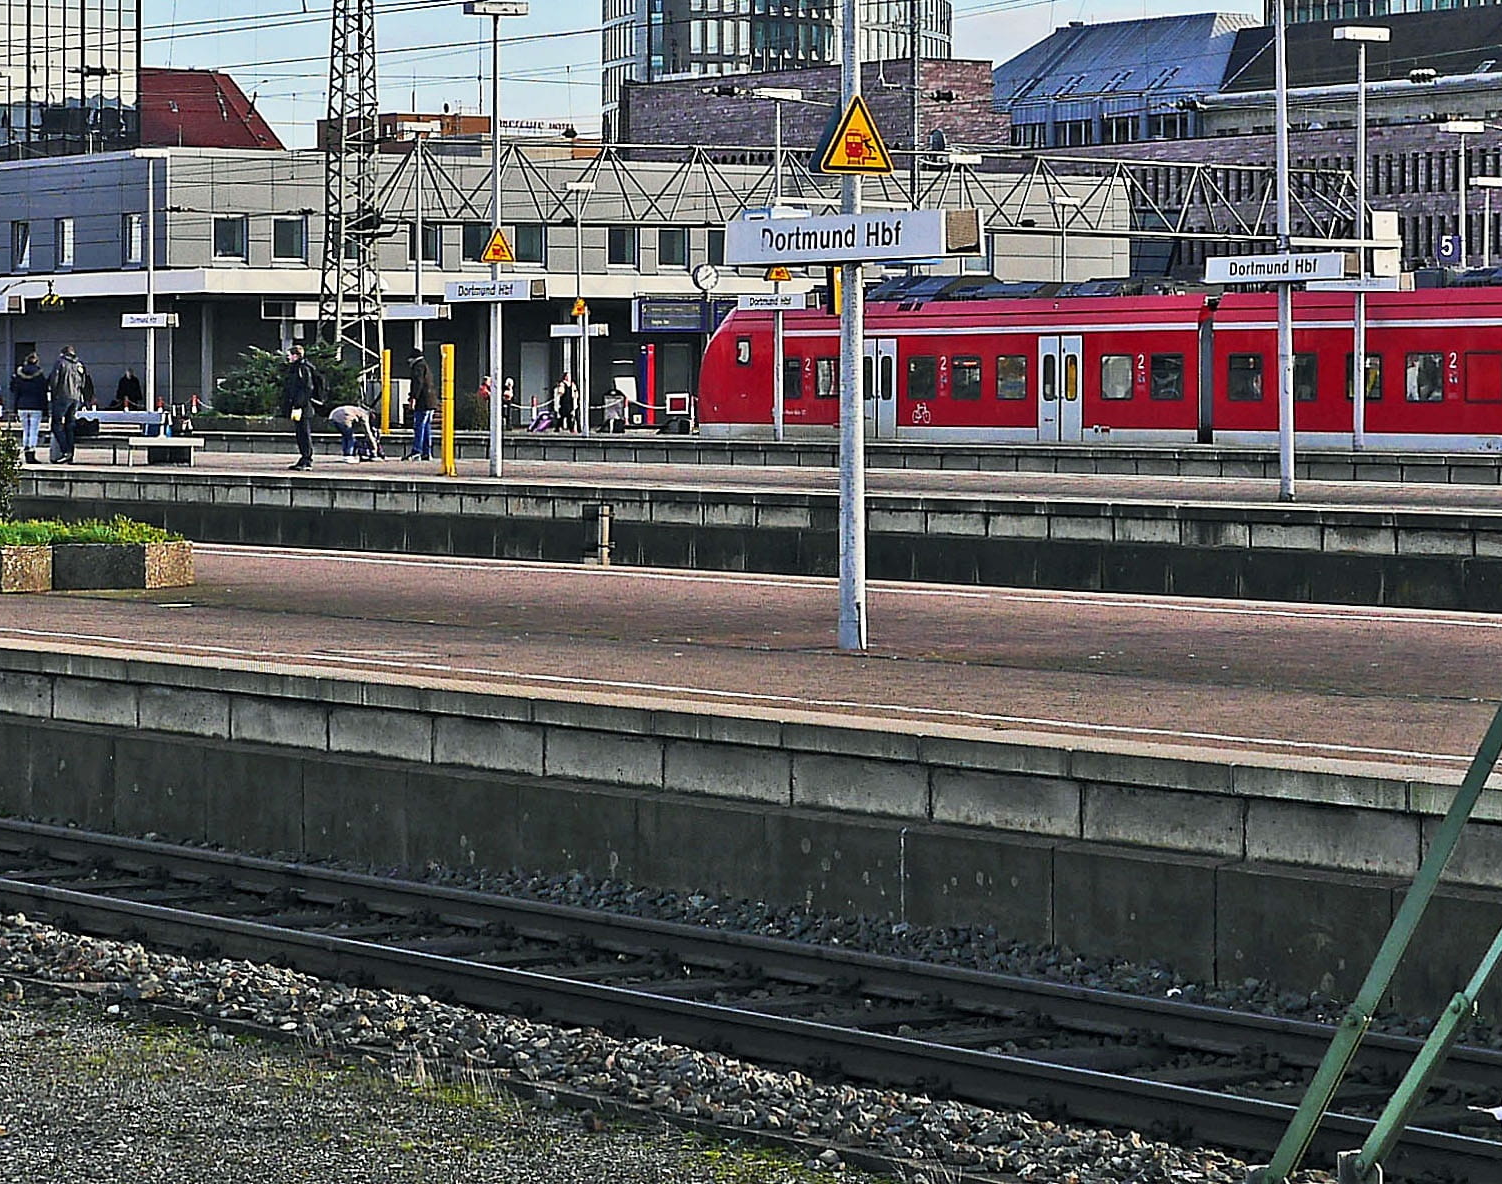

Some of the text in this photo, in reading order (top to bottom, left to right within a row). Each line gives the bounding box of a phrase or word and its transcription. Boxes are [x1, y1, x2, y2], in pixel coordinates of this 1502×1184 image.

[761, 220, 903, 252] Dortmund Hbf
[1440, 235, 1454, 256] 5
[1229, 257, 1319, 276] Dortmund Hbf
[457, 284, 514, 297] Dortmund Hbf
[804, 357, 812, 372] 2
[940, 356, 947, 371] 2
[1138, 354, 1145, 369] 2
[1449, 352, 1457, 368] 2
